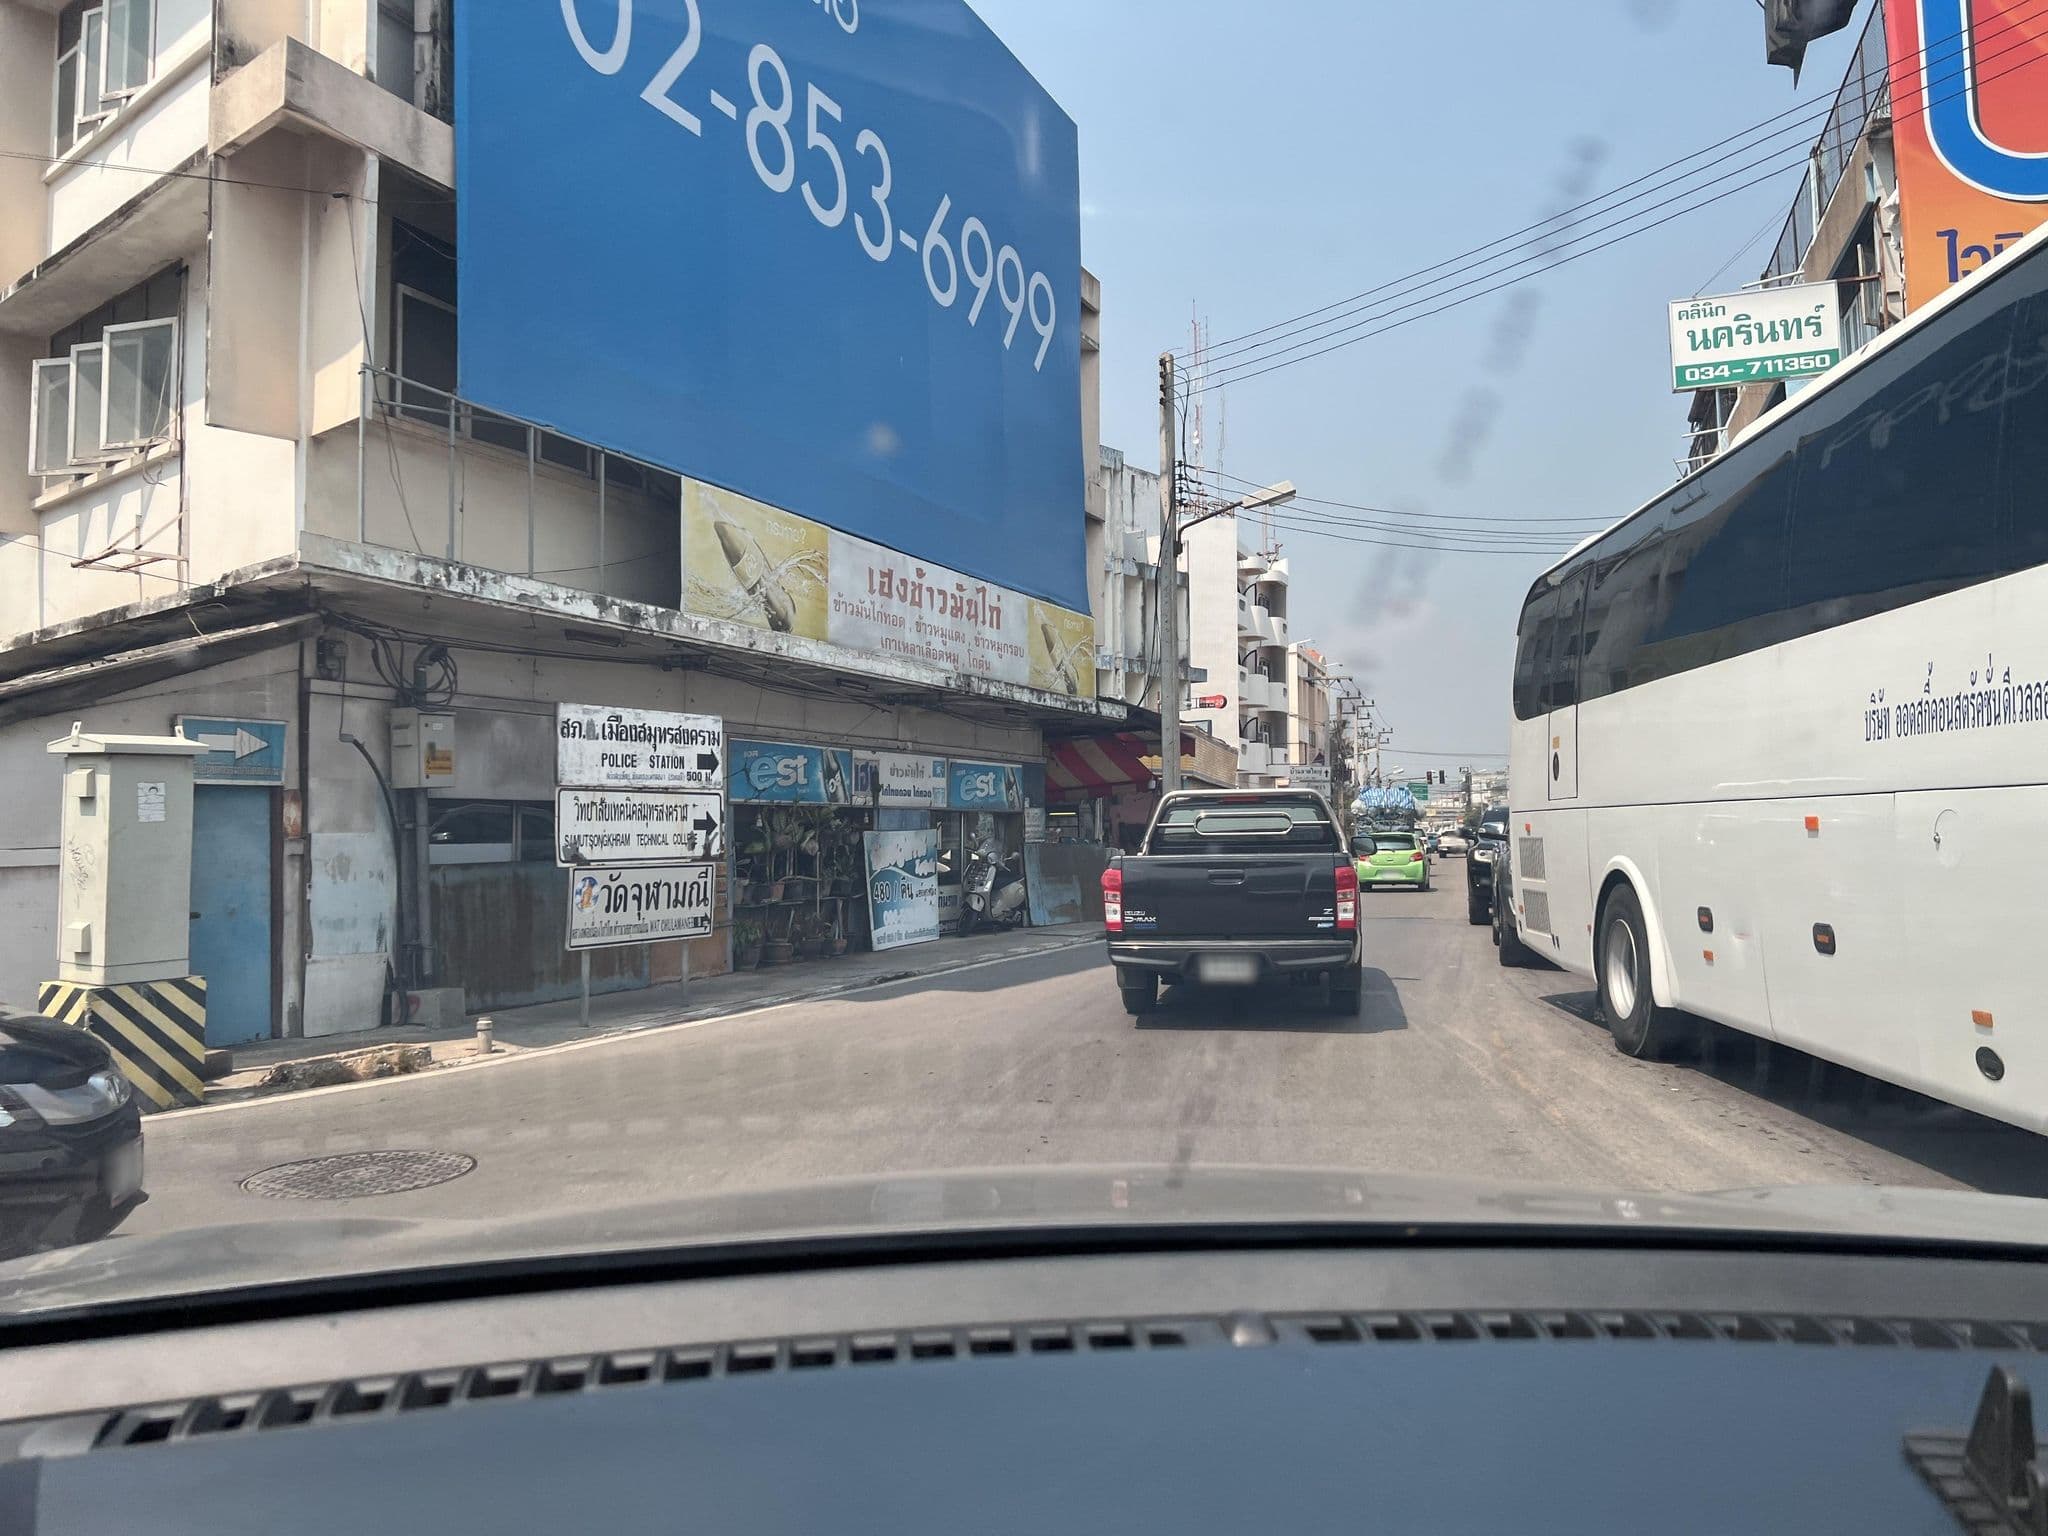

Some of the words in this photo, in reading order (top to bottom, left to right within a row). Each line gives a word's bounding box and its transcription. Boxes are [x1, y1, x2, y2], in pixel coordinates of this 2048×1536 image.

[1678, 302, 1726, 321] คลินิก
[1686, 304, 1825, 352] นครินทร์
[1685, 354, 1831, 381] 034-711350
[867, 566, 1002, 630] เฮงข้าวมันไก่
[880, 636, 960, 670] เกาเหลาเลือดหมู
[1864, 687, 1891, 742] บริษัท
[601, 714, 720, 752] เมืองสมุทรสงคราม
[601, 752, 637, 768] POLICE
[649, 754, 685, 770] STATION
[686, 771, 702, 782] 500
[749, 754, 808, 791] est
[959, 771, 996, 801] est
[572, 795, 689, 828] วิทยาลัยเทคนิคสมุทรสงคราม
[636, 833, 669, 846] TECHNICAL
[600, 868, 709, 921] วัดจุฬามณี
[873, 880, 891, 903] 480
